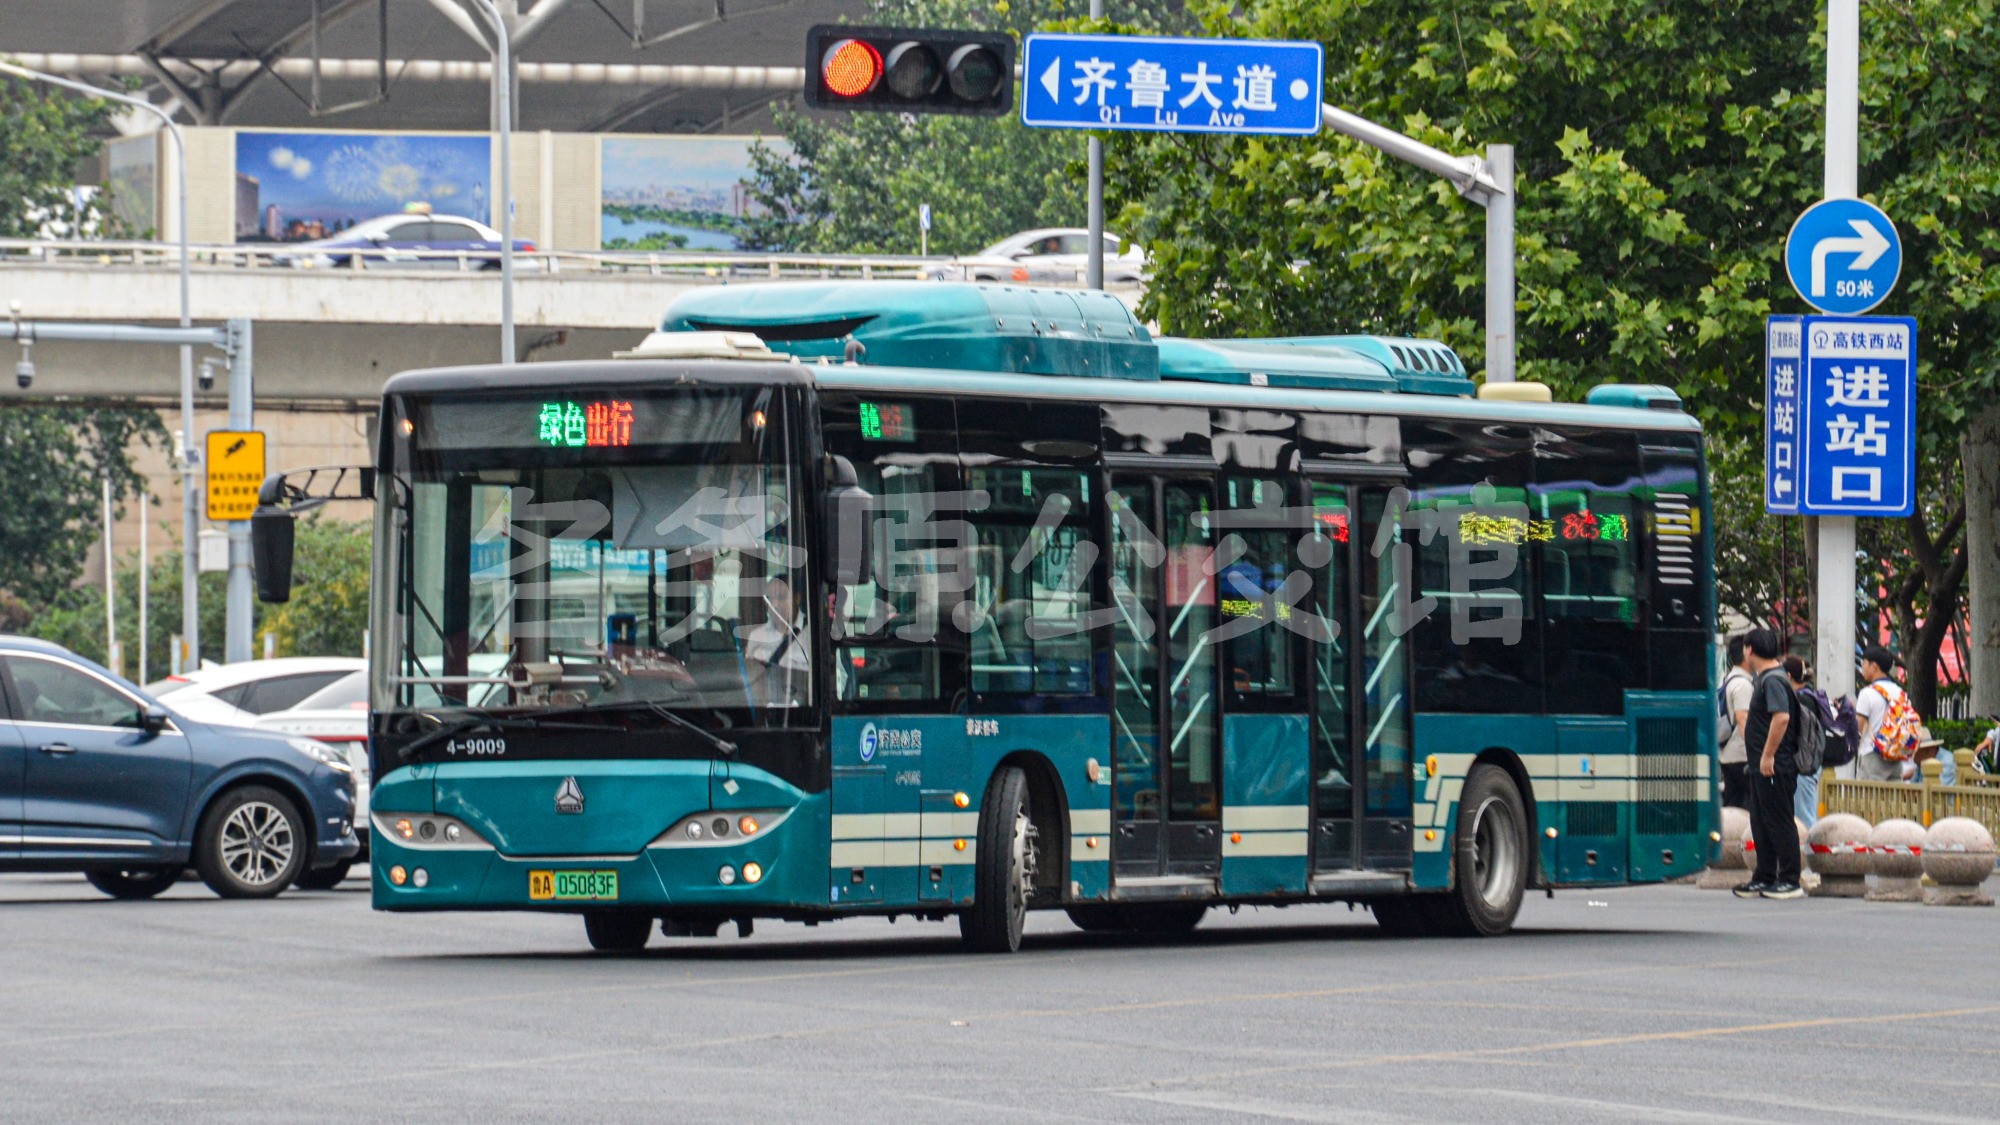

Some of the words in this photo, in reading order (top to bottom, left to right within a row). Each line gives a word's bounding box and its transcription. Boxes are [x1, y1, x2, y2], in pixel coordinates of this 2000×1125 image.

[1071, 57, 1277, 111] 齐鲁大道
[1099, 105, 1121, 124] Qi
[1155, 106, 1178, 125] Lu
[1208, 108, 1245, 127] Ave
[1835, 278, 1875, 299] 50米
[1832, 331, 1904, 351] 高铁西站
[539, 400, 634, 447] 绿色出行
[1774, 364, 1794, 470] 进站口
[1825, 365, 1890, 502] 进站口
[446, 738, 506, 755] 4-9009
